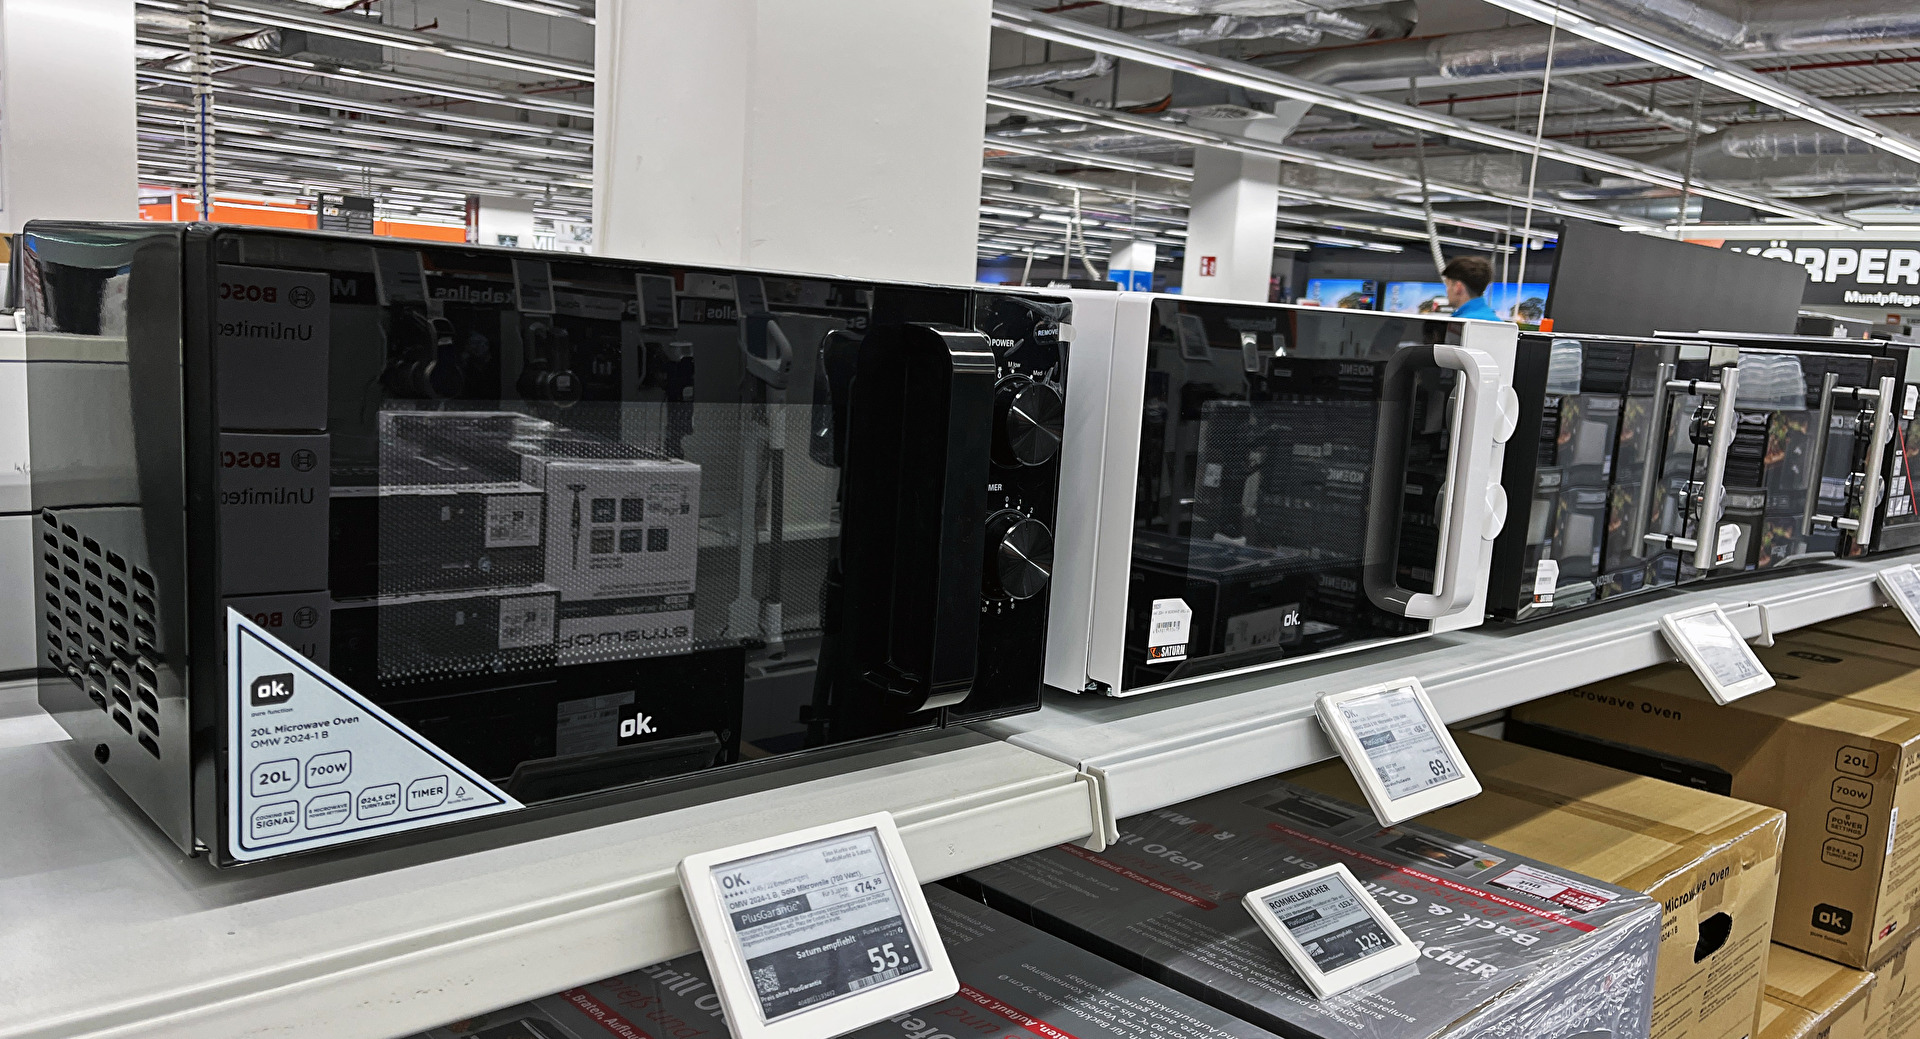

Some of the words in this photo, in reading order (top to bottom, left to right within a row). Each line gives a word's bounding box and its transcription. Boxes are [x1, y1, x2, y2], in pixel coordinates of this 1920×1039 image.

[992, 339, 1014, 347] POWER
[1284, 611, 1300, 627] ok.
[1161, 645, 1186, 658] SATURN
[257, 680, 289, 698] ok.
[1641, 702, 1681, 720] Oven
[250, 728, 272, 737] 20L
[274, 720, 330, 734] Microwave
[332, 715, 360, 726] Oven
[620, 712, 657, 738] ok.
[250, 736, 281, 749] OMW
[283, 732, 319, 745] 2024-1
[321, 731, 329, 739] B
[310, 762, 348, 776] 700W
[1843, 754, 1870, 769] 20L
[259, 771, 292, 786] 20L
[411, 786, 444, 799] TIMER
[1836, 786, 1868, 800] 700W
[361, 800, 396, 810] TURNTABLE
[255, 816, 296, 830] SIGNAL
[1831, 817, 1863, 830] POWER
[1831, 823, 1862, 836] SETTINGS
[1143, 844, 1204, 871] Ofen
[722, 873, 751, 889] OK.
[1402, 868, 1440, 883] Braten,
[1709, 866, 1730, 885] Oven
[729, 899, 748, 910] OMW
[781, 887, 796, 897] Solo
[796, 879, 829, 894] Mikrowelle
[1269, 884, 1331, 910] ROMMELSBACHER
[1442, 880, 1486, 898] Kuchen,
[1428, 902, 1453, 916] &
[1457, 913, 1540, 947] Back
[1661, 916, 1677, 931] rowelle
[1818, 911, 1847, 929] ok.
[796, 945, 822, 959] Saturn
[822, 935, 857, 954] empfiehlt
[1197, 956, 1244, 981] Bratblech,
[1247, 976, 1285, 997] Grillrost
[1286, 995, 1309, 1006] und
[1218, 955, 1249, 973] 2-fach
[1250, 969, 1295, 991] verglaste
[1008, 978, 1024, 987] cm
[1022, 985, 1037, 994] 29
[960, 986, 991, 1006] Pizza
[1037, 992, 1052, 1002] bis
[1105, 991, 1152, 1013] getrennt
[572, 994, 606, 1020] Braten,
[1063, 993, 1118, 1021] Vorheizzeit
[1098, 999, 1120, 1011] 230
[1119, 1008, 1136, 1018] bis
[990, 1001, 1038, 1027] Auflauf,
[1052, 998, 1112, 1029] Backformen
[1150, 1011, 1176, 1026] auch
[1109, 1024, 1127, 1037] für
[1118, 1018, 1147, 1035] kurze
[1150, 1022, 1167, 1031] 80
